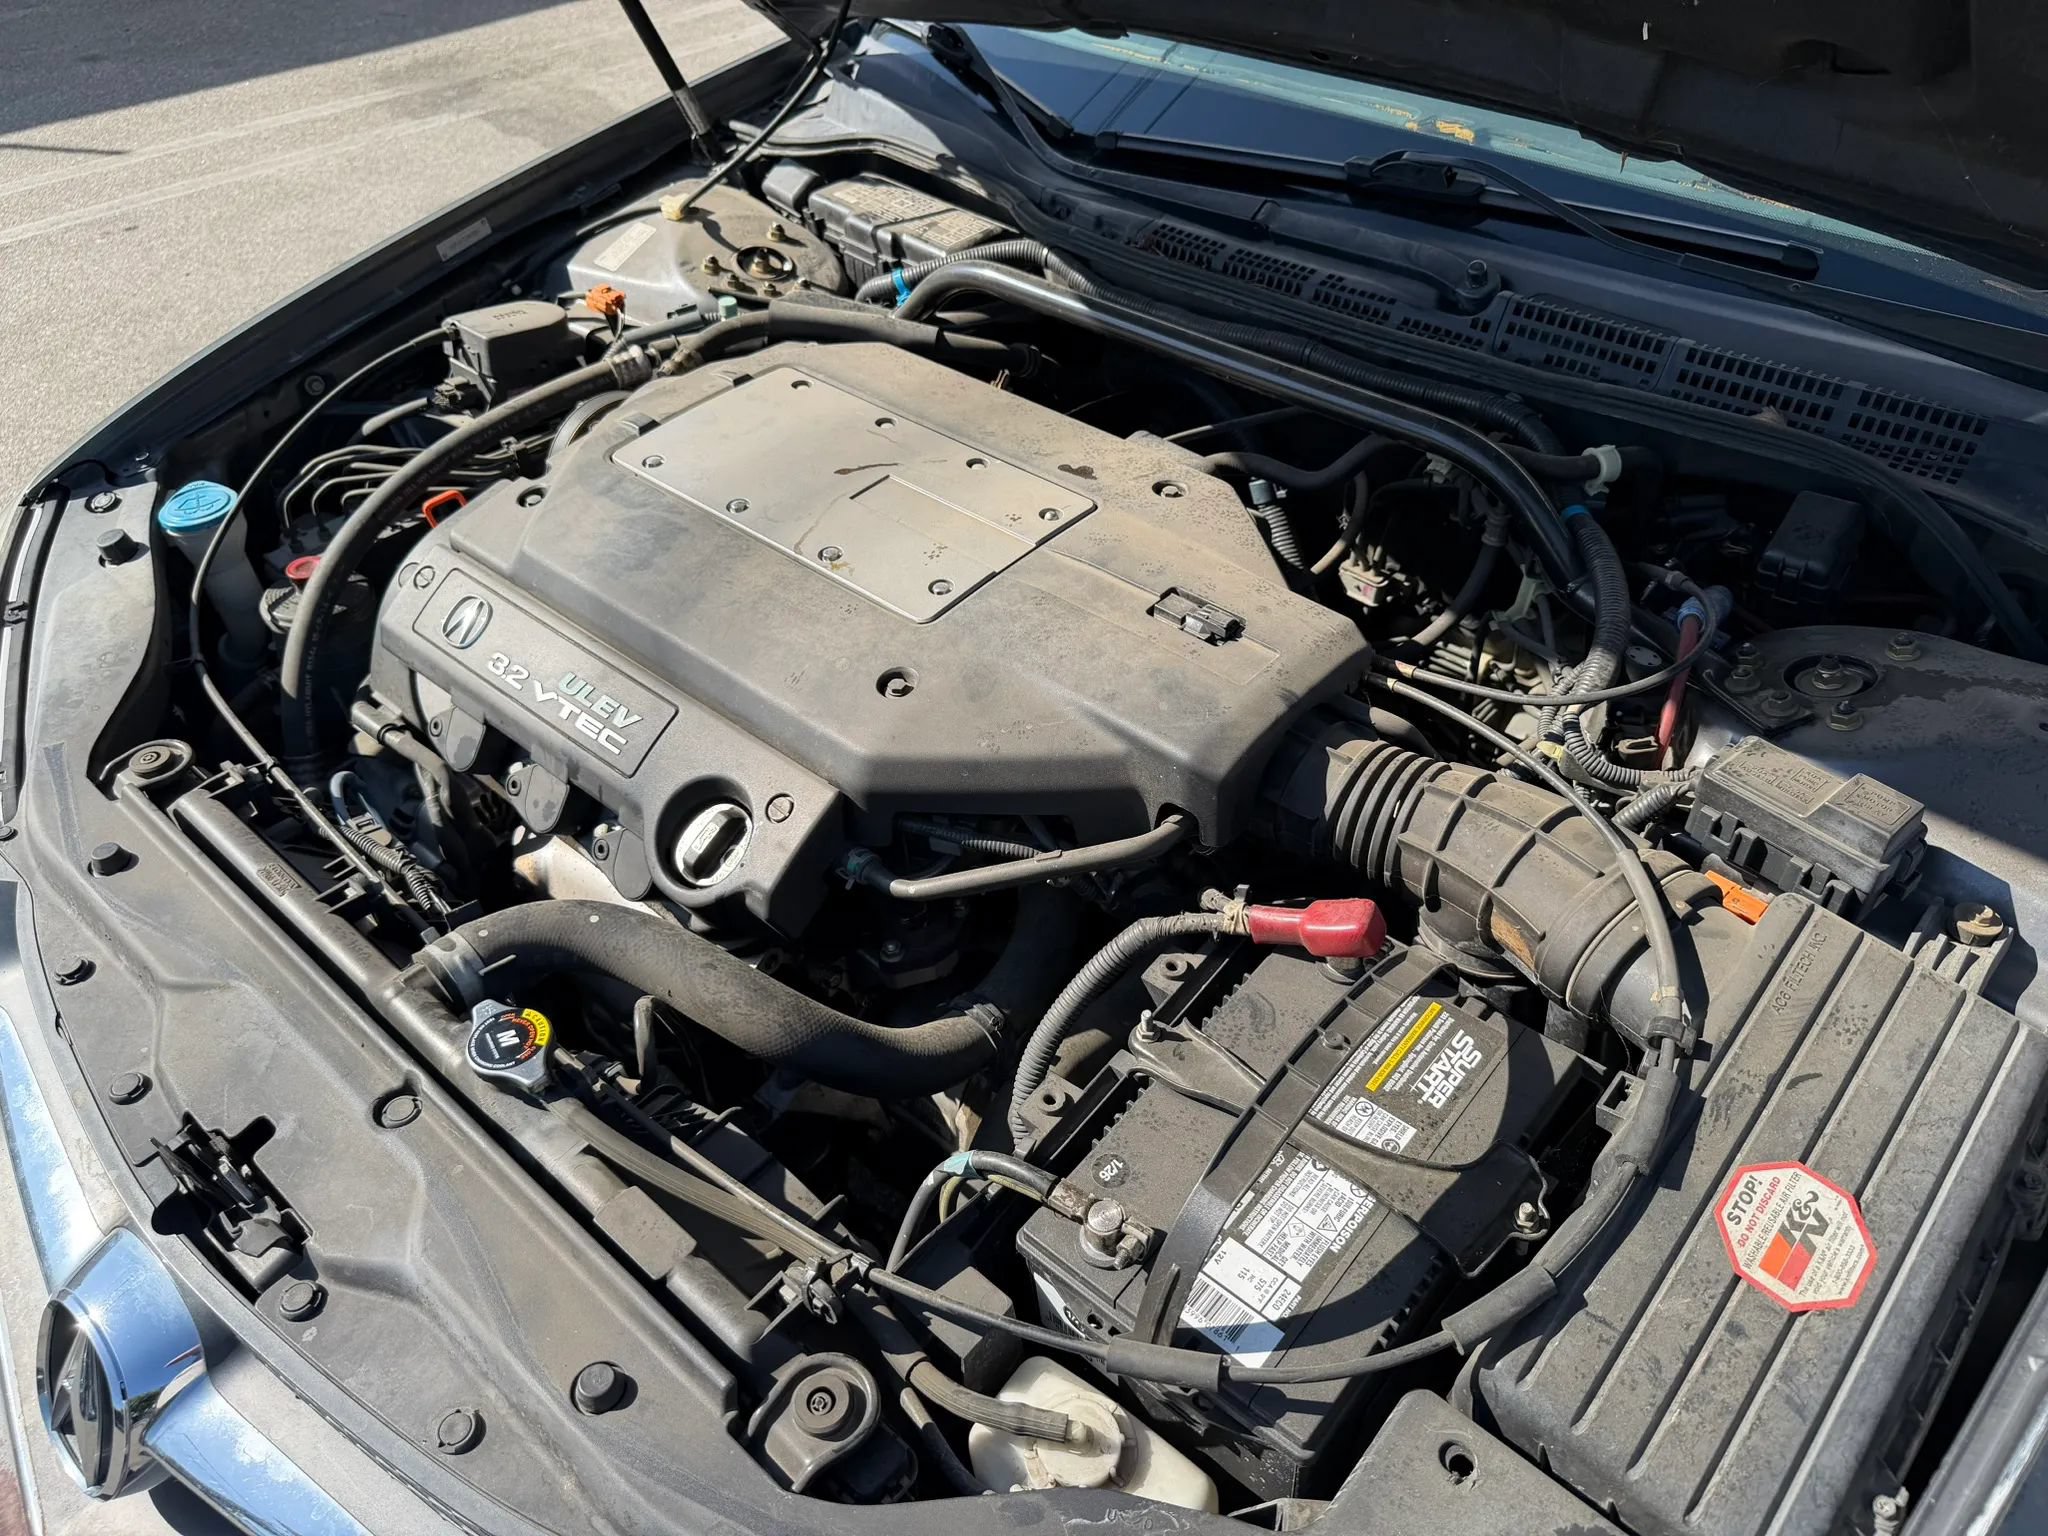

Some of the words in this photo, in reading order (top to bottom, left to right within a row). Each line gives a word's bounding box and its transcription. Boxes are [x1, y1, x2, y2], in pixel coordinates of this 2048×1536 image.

[487, 652, 530, 690] 3.2
[533, 679, 628, 755] VTEC
[558, 672, 643, 729] ULEV
[1782, 948, 1817, 992] FILTECH
[532, 1015, 546, 1041] CAUTION
[496, 1030, 520, 1047] M
[1416, 1029, 1474, 1103] START
[1428, 1045, 1482, 1110] SUPER
[1374, 1115, 1395, 1139] EXPLOSIVE
[1394, 1124, 1409, 1141] SHIELD
[1099, 1159, 1123, 1181] 1/26
[1783, 1170, 1801, 1193] FILTER
[1333, 1194, 1346, 1208] ACID
[1727, 1175, 1763, 1226] STOP!
[1778, 1191, 1790, 1204] AIR
[1332, 1198, 1353, 1222] SULFURIC
[1736, 1232, 1750, 1247] DO
[1743, 1212, 1761, 1233] NOT
[1753, 1175, 1783, 1214] DISCARD
[1274, 1231, 1287, 1245] HELP
[1302, 1230, 1316, 1245] WITH
[1741, 1201, 1785, 1269] WASHABLE/REUSABLE
[1211, 1246, 1228, 1266] 12V
[1264, 1242, 1278, 1258] FAST.
[1270, 1239, 1290, 1263] MEDICAL
[1289, 1242, 1307, 1262] WATER.
[1295, 1233, 1323, 1267] IMMEDIATELY
[1313, 1238, 1329, 1256] FLUSH
[1276, 1254, 1288, 1267] GET
[1304, 1252, 1318, 1267] EYES
[1236, 1265, 1250, 1280] 115
[1266, 1276, 1279, 1289] CCA
[1252, 1276, 1267, 1292] 575
[1287, 1293, 1302, 1310] PART
